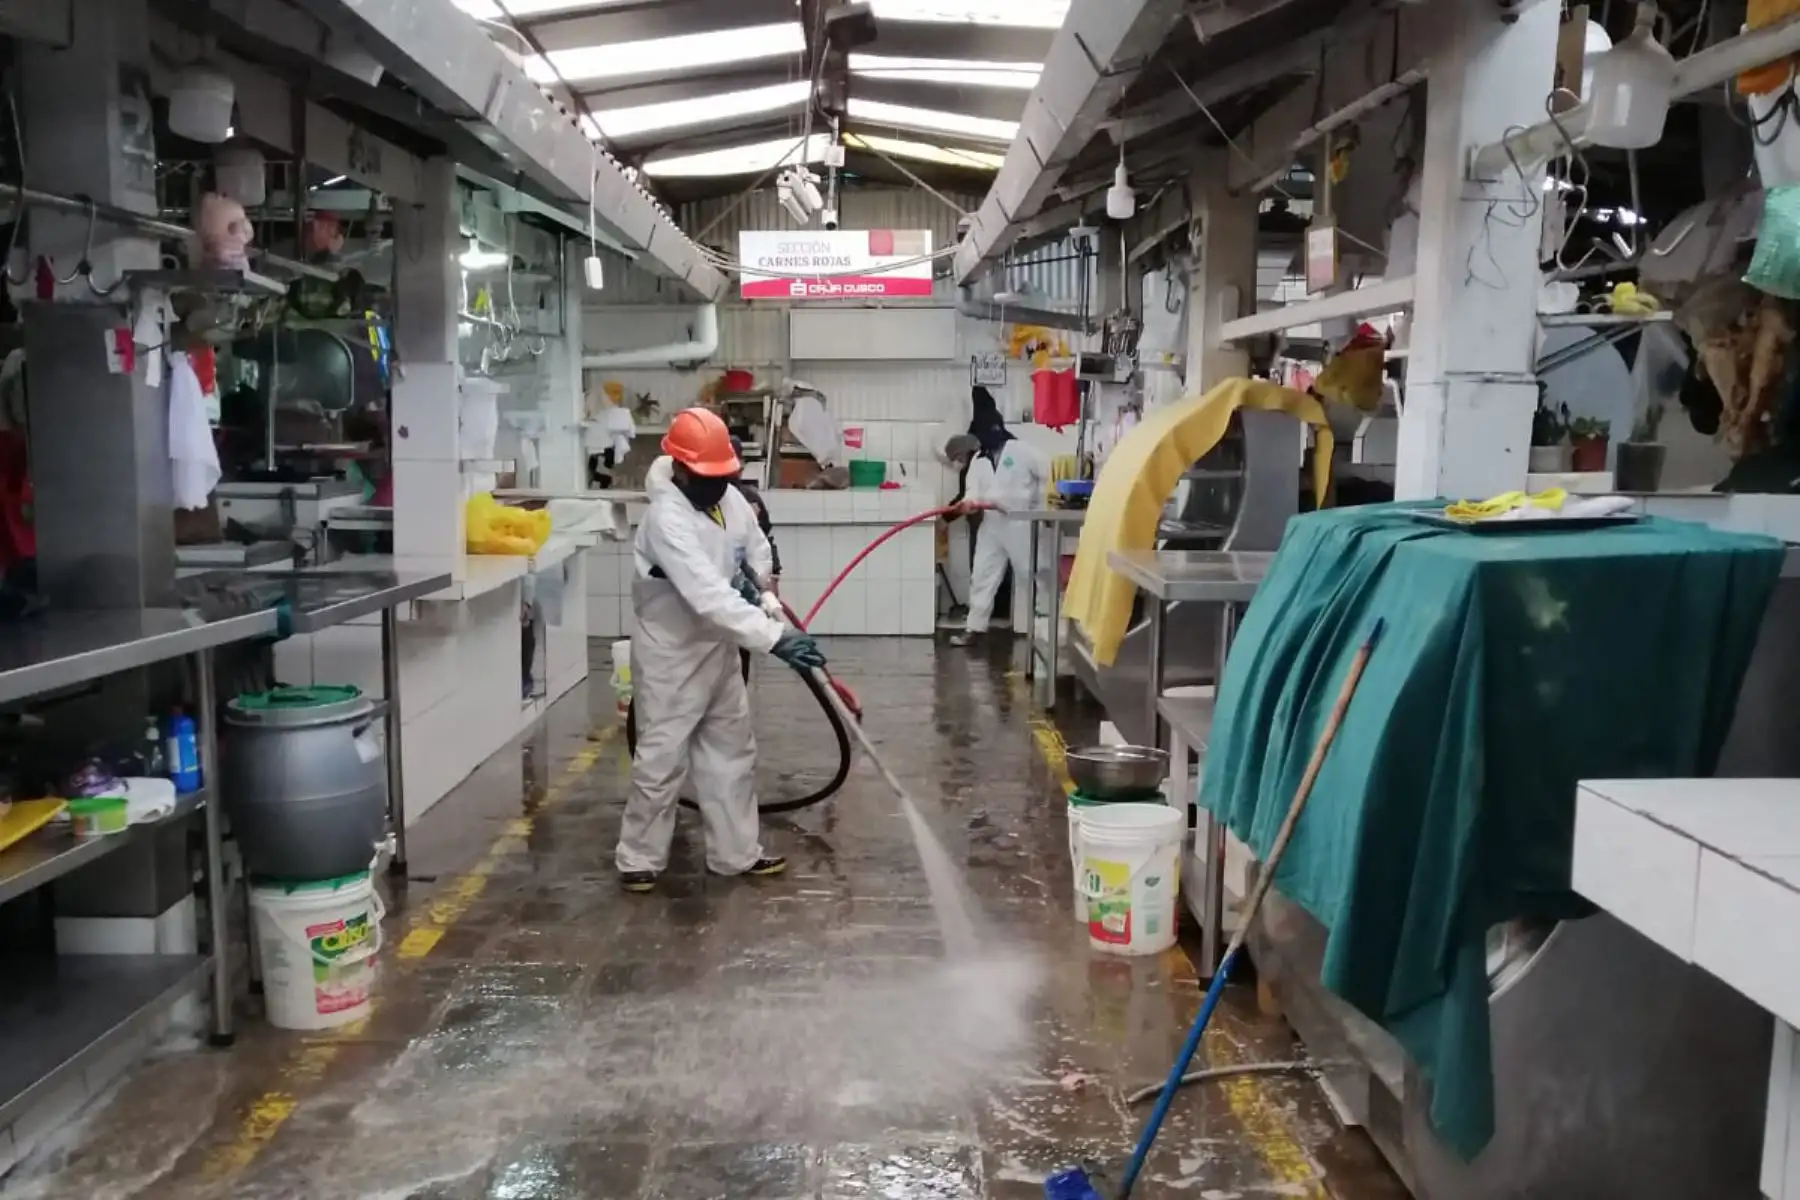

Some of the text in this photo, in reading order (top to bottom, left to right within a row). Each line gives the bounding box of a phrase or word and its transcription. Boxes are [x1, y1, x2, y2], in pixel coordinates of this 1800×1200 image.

[758, 256, 851, 267] CARNES ROJAS
[843, 283, 885, 293] CUSCO
